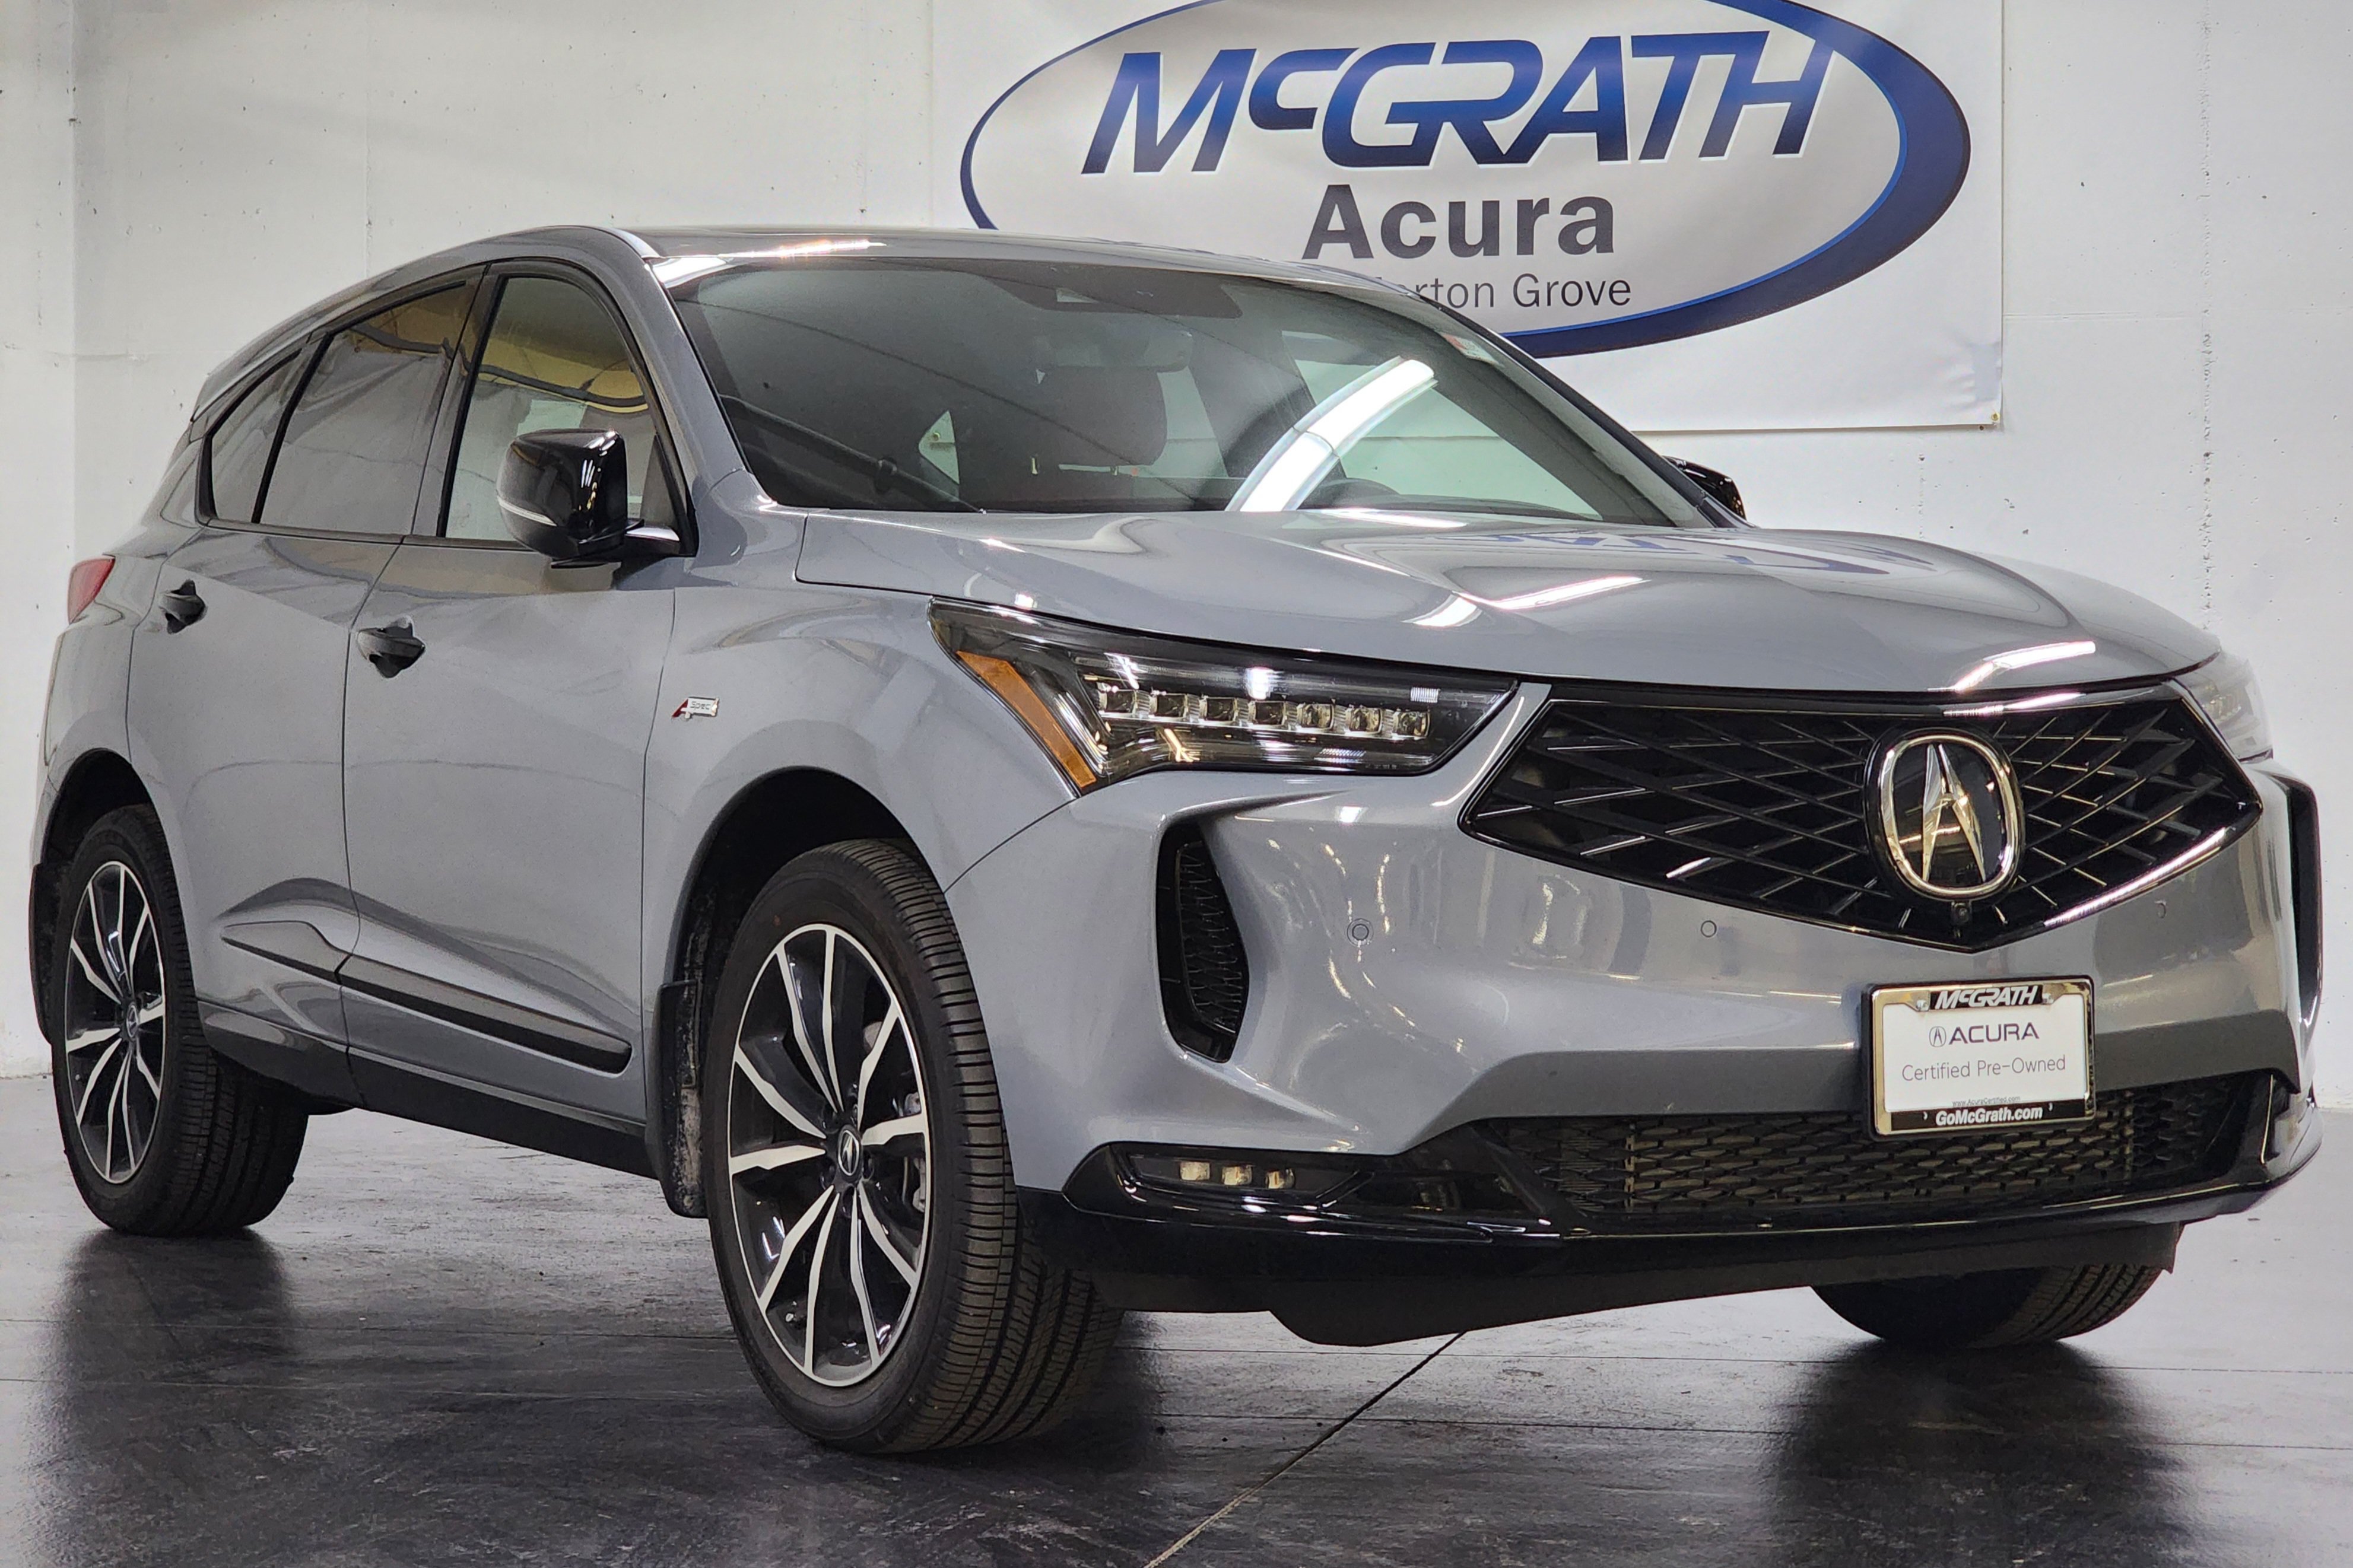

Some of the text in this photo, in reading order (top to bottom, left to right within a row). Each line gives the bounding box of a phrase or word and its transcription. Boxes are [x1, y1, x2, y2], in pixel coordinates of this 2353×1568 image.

[1301, 183, 1614, 260] Acura
[1375, 273, 1631, 308] rton Grove
[1949, 1022, 2040, 1045] ACURA
[1901, 1054, 2066, 1082] Certified Pre-Owned
[1935, 1106, 2043, 1127] GoMcGrath.com
